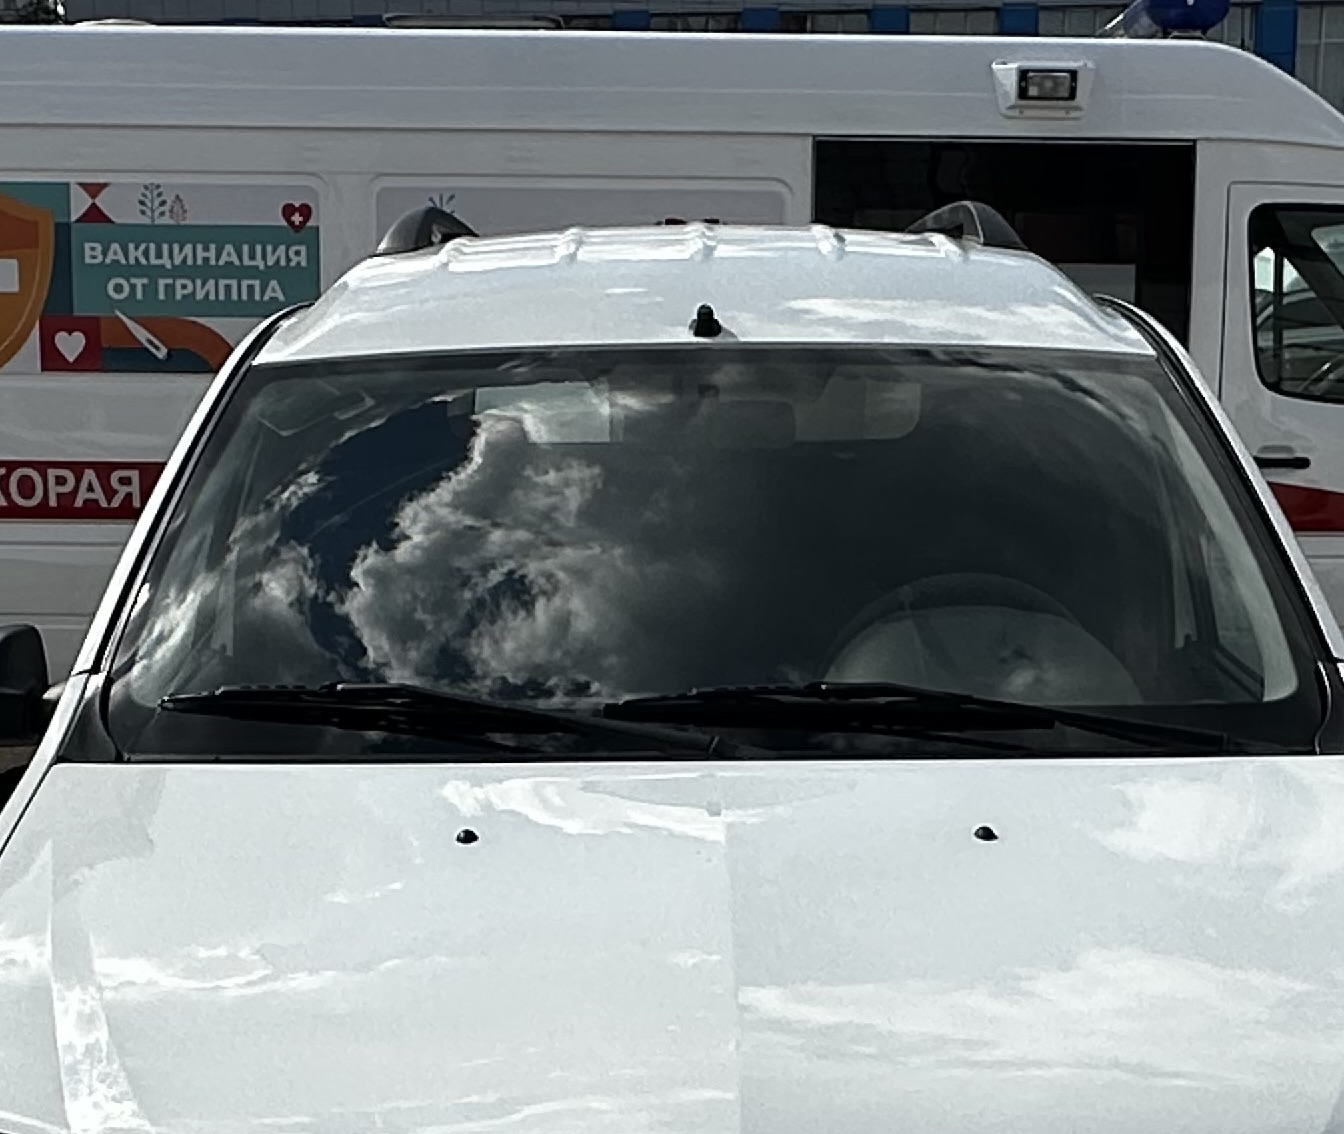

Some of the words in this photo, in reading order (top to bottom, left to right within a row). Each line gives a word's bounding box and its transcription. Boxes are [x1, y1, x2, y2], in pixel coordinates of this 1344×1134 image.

[84, 242, 308, 269] ВАКЦИНАЦИЯ
[107, 277, 147, 301] ОТ
[157, 277, 286, 302] ГРИППА
